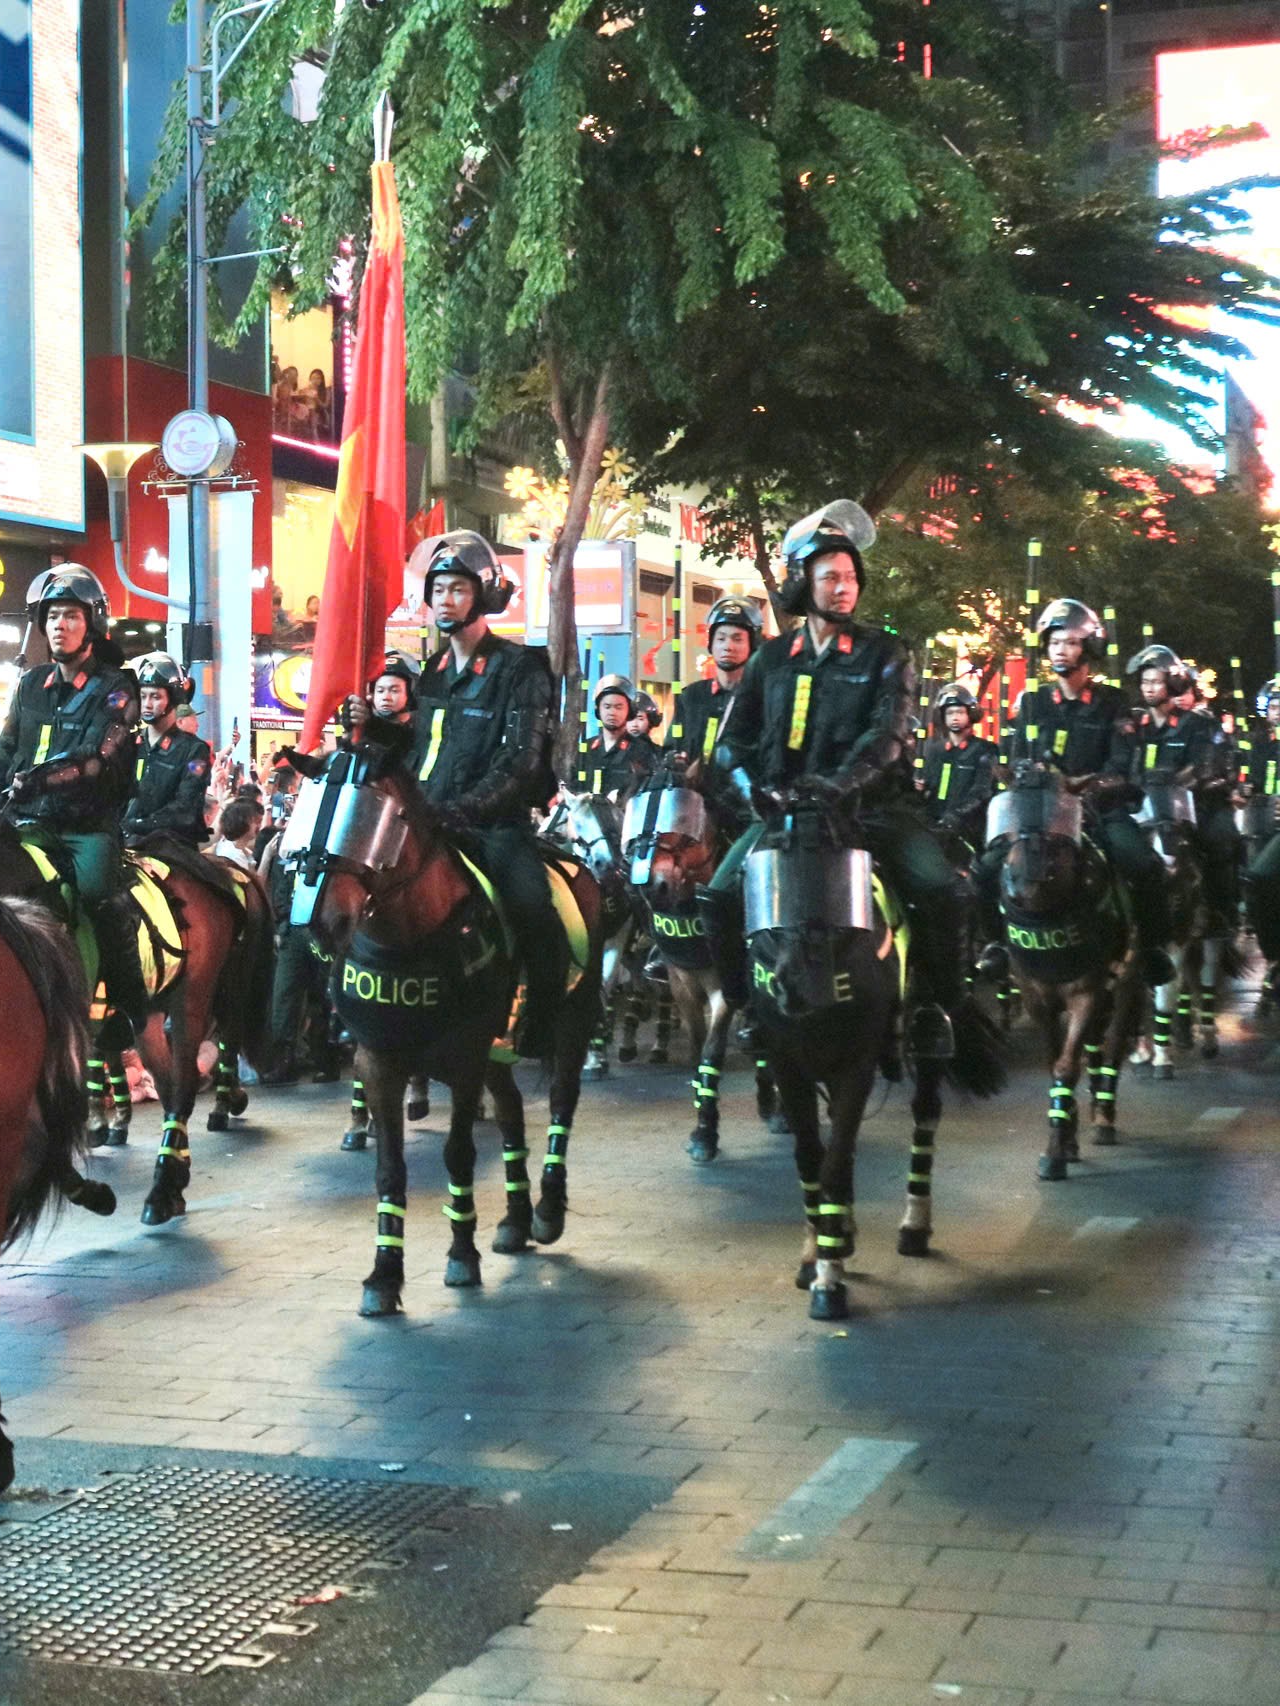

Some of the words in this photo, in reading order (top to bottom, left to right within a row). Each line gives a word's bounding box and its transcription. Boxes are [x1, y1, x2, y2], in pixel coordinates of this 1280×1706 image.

[652, 913, 706, 937] POLIC
[1007, 925, 1081, 949] POLICE
[343, 963, 440, 1006] POLICE
